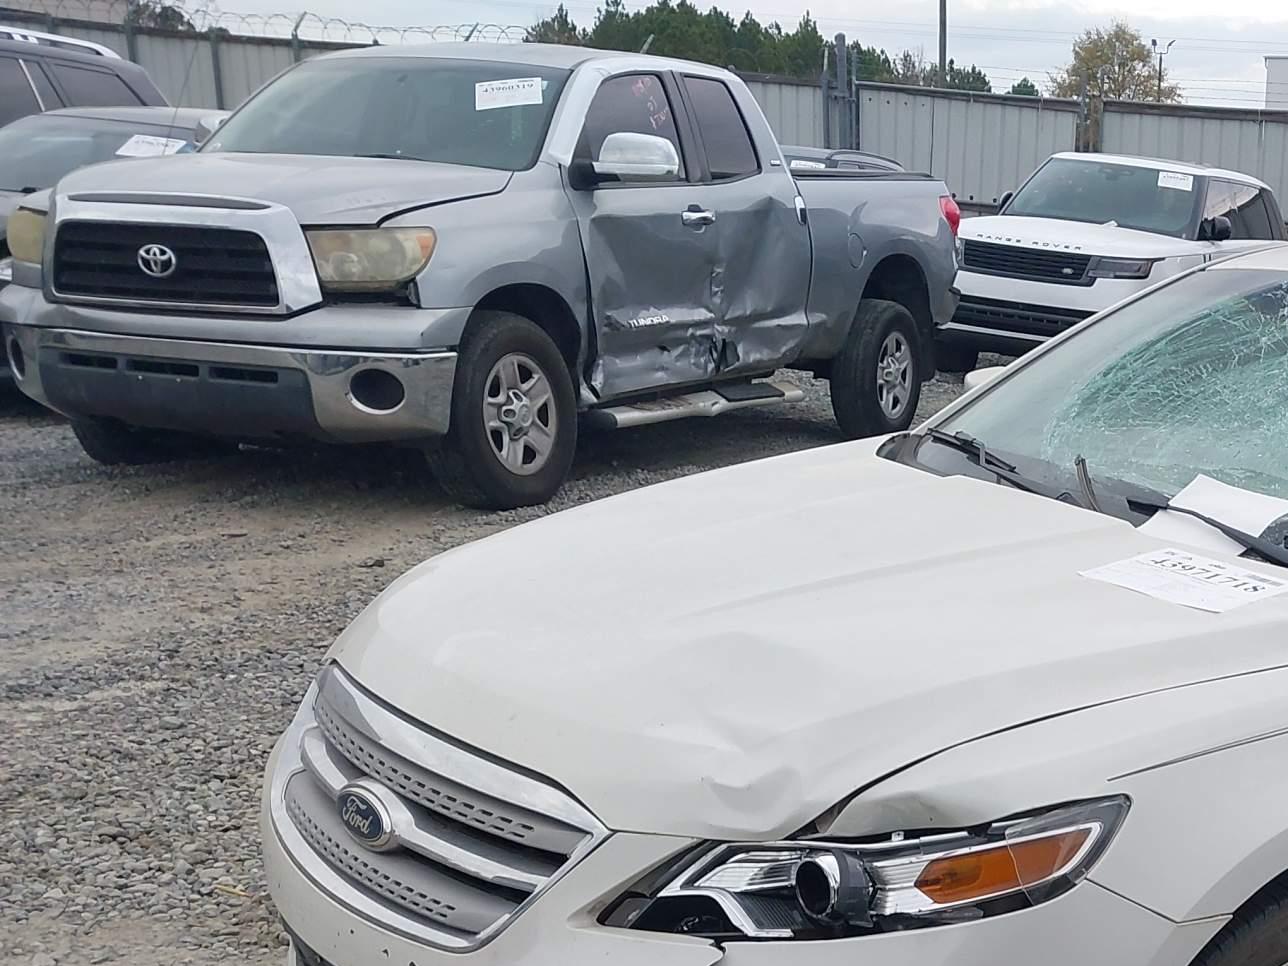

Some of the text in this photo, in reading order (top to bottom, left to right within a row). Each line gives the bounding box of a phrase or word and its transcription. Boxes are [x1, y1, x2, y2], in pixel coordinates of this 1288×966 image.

[977, 233, 1082, 250] RANGE ROVER
[627, 314, 669, 328] TUNDRA
[1150, 557, 1266, 593] 43971718
[343, 796, 373, 834] Ford
